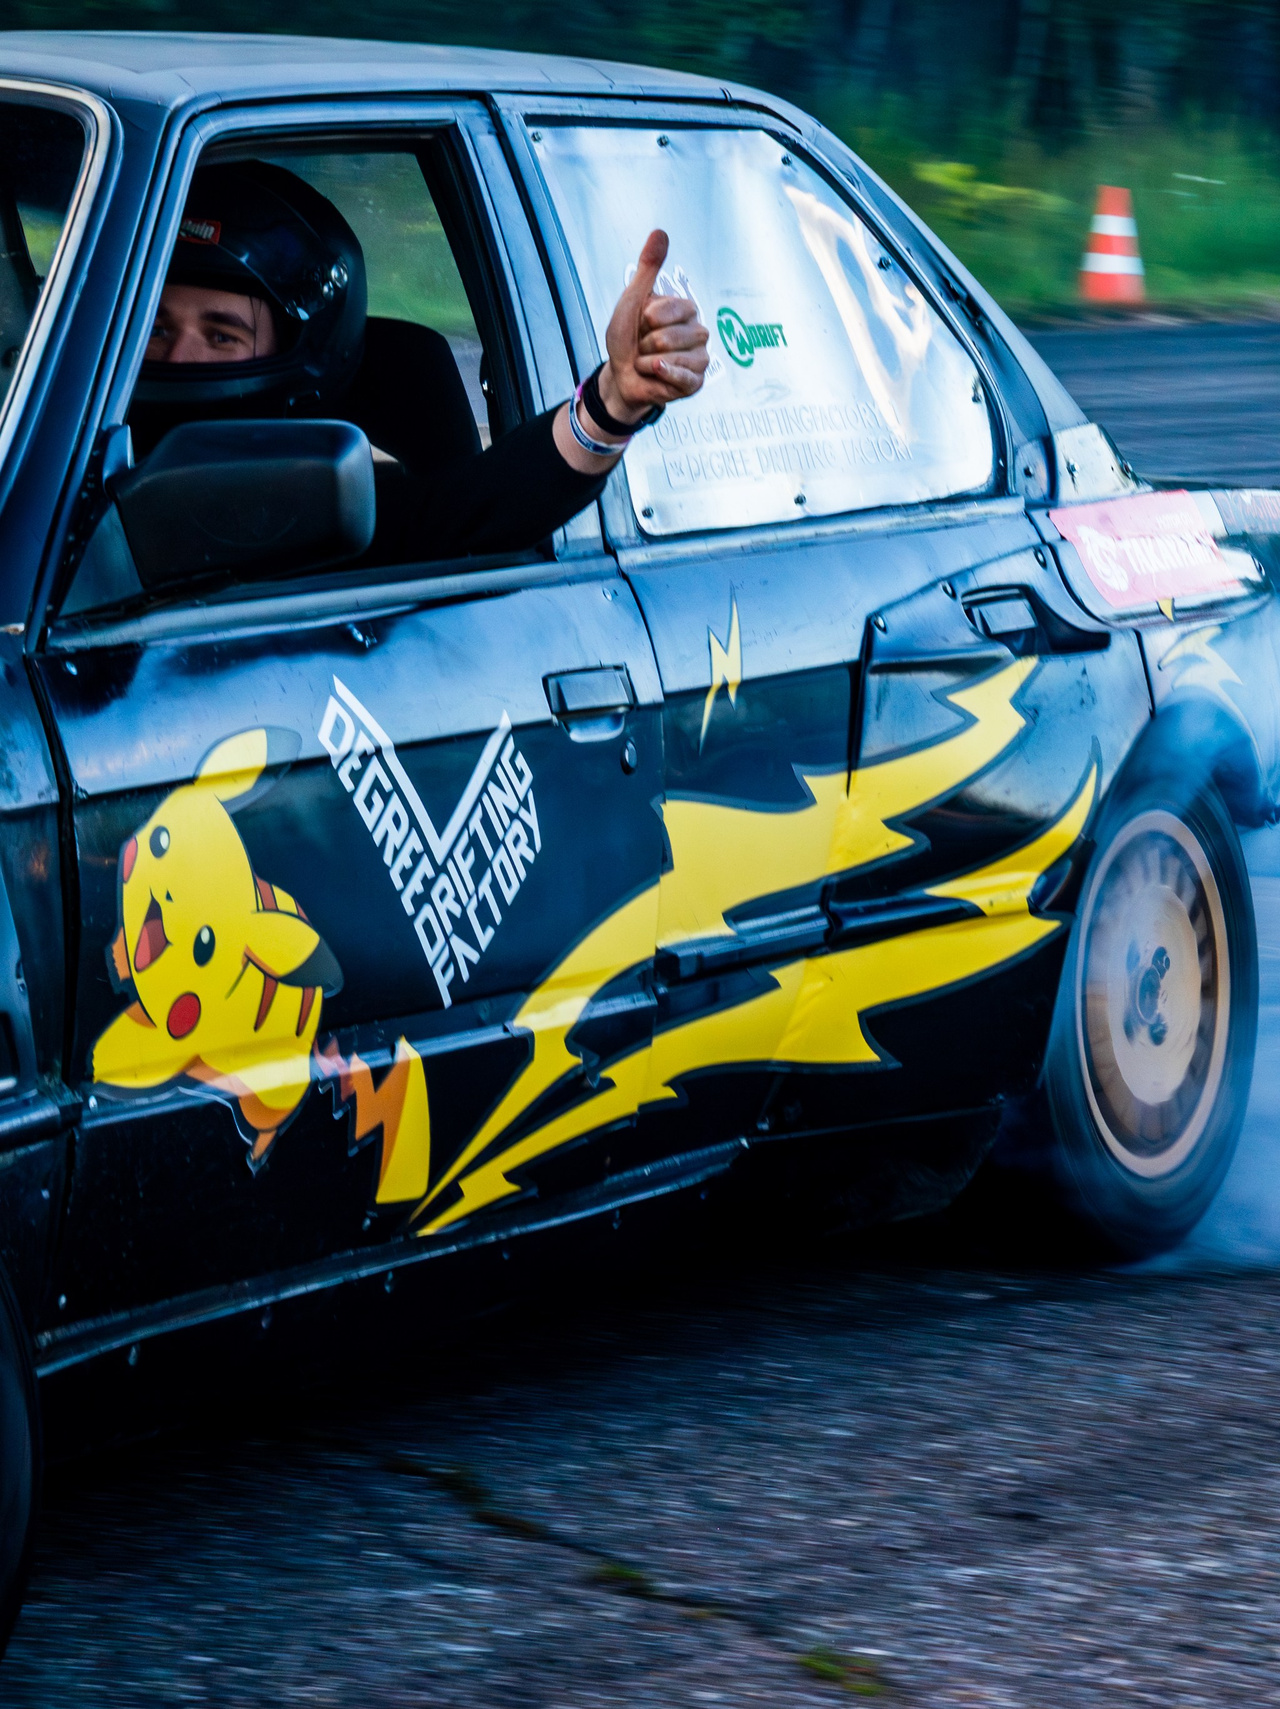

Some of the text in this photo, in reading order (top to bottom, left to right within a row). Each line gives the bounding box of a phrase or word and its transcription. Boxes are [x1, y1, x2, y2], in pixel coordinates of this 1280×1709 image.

[318, 695, 435, 916] DEGREE
[413, 734, 534, 967] DRIFTING
[433, 788, 542, 1009] FACTORY
